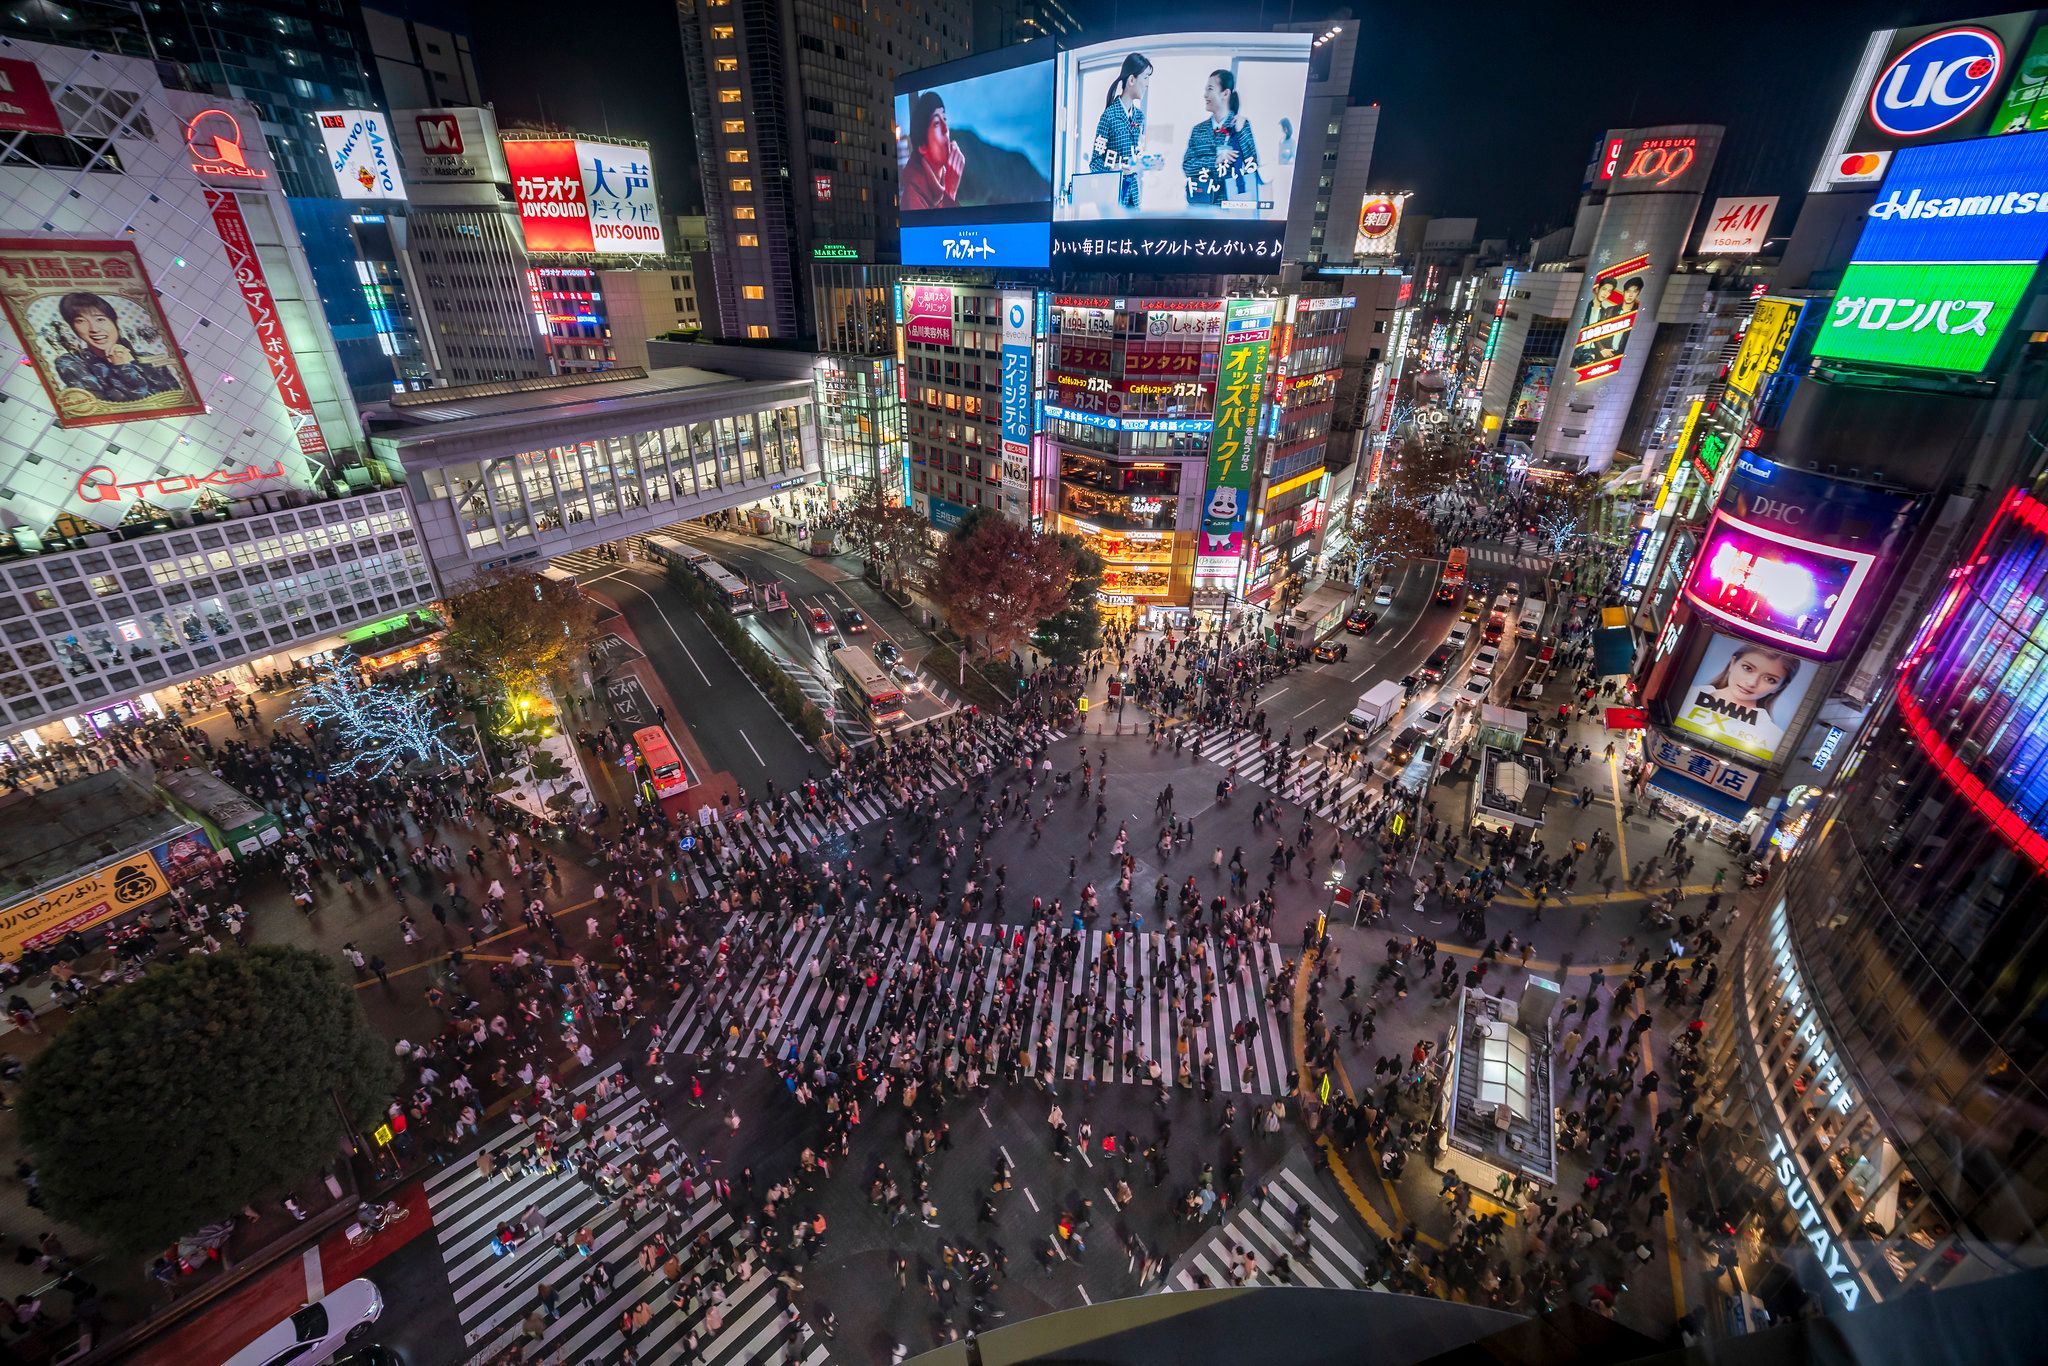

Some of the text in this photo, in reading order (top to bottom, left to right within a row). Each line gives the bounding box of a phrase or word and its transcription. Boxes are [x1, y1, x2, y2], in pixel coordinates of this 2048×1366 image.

[334, 122, 363, 173] SANKYO
[1642, 138, 1696, 148] SHIBUYA
[365, 119, 394, 192] SANKYO
[1622, 146, 1695, 186] 109
[191, 163, 268, 178] TOKYU
[435, 166, 477, 177] MasterCard
[584, 158, 650, 199] 大声
[517, 176, 580, 201] カラオケ
[522, 201, 587, 218] JOYSOUND
[590, 200, 654, 223] だそうぜ
[1713, 203, 1770, 232] H&M
[594, 224, 660, 241] JOYSOUND
[942, 237, 996, 260] アルフォート
[1141, 300, 1223, 312] しゃぶしゃぶバイキング
[1832, 296, 1995, 337] サロンパス
[1051, 315, 1061, 325] 9F
[1173, 316, 1221, 333] しゃぶ葉
[1126, 354, 1198, 370] コンタクト
[1005, 353, 1018, 435] アイシティ
[1018, 354, 1028, 437] コンタクトの
[1087, 377, 1112, 393] ガスト
[1172, 383, 1208, 397] ガスト
[1074, 392, 1104, 411] ガスト
[1150, 420, 1212, 431] 英会話イーオン
[1217, 347, 1252, 481] オッズパーク!
[118, 461, 285, 498] TOKYU
[1751, 495, 1805, 525] DHC
[1687, 707, 1731, 732] FX
[1694, 691, 1758, 726] DMM
[1768, 1132, 1861, 1313] TSUTAYA
